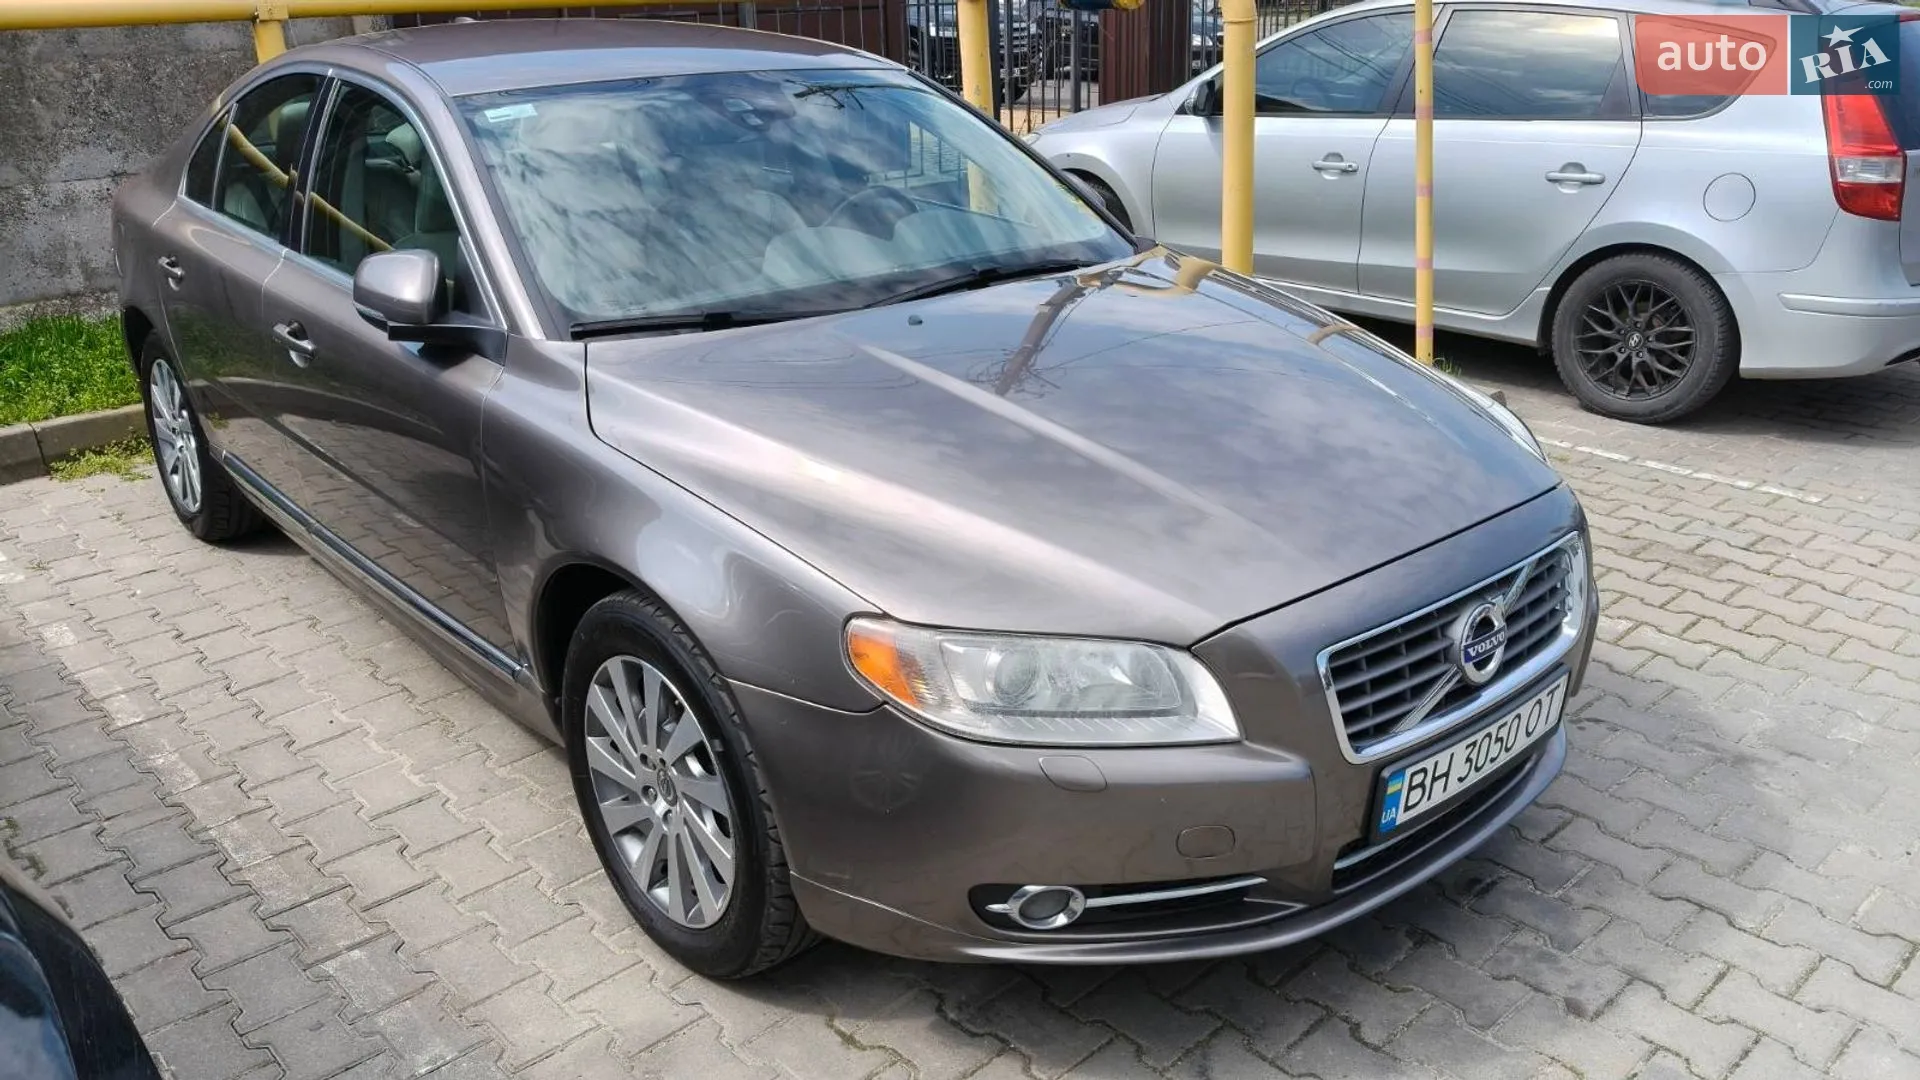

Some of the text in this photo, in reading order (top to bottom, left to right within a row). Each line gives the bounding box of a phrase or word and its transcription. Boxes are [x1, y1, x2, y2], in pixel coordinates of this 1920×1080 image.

[1467, 631, 1505, 657] VOLVO
[1402, 683, 1561, 814] BH 3050 OT
[1381, 806, 1396, 824] UA
